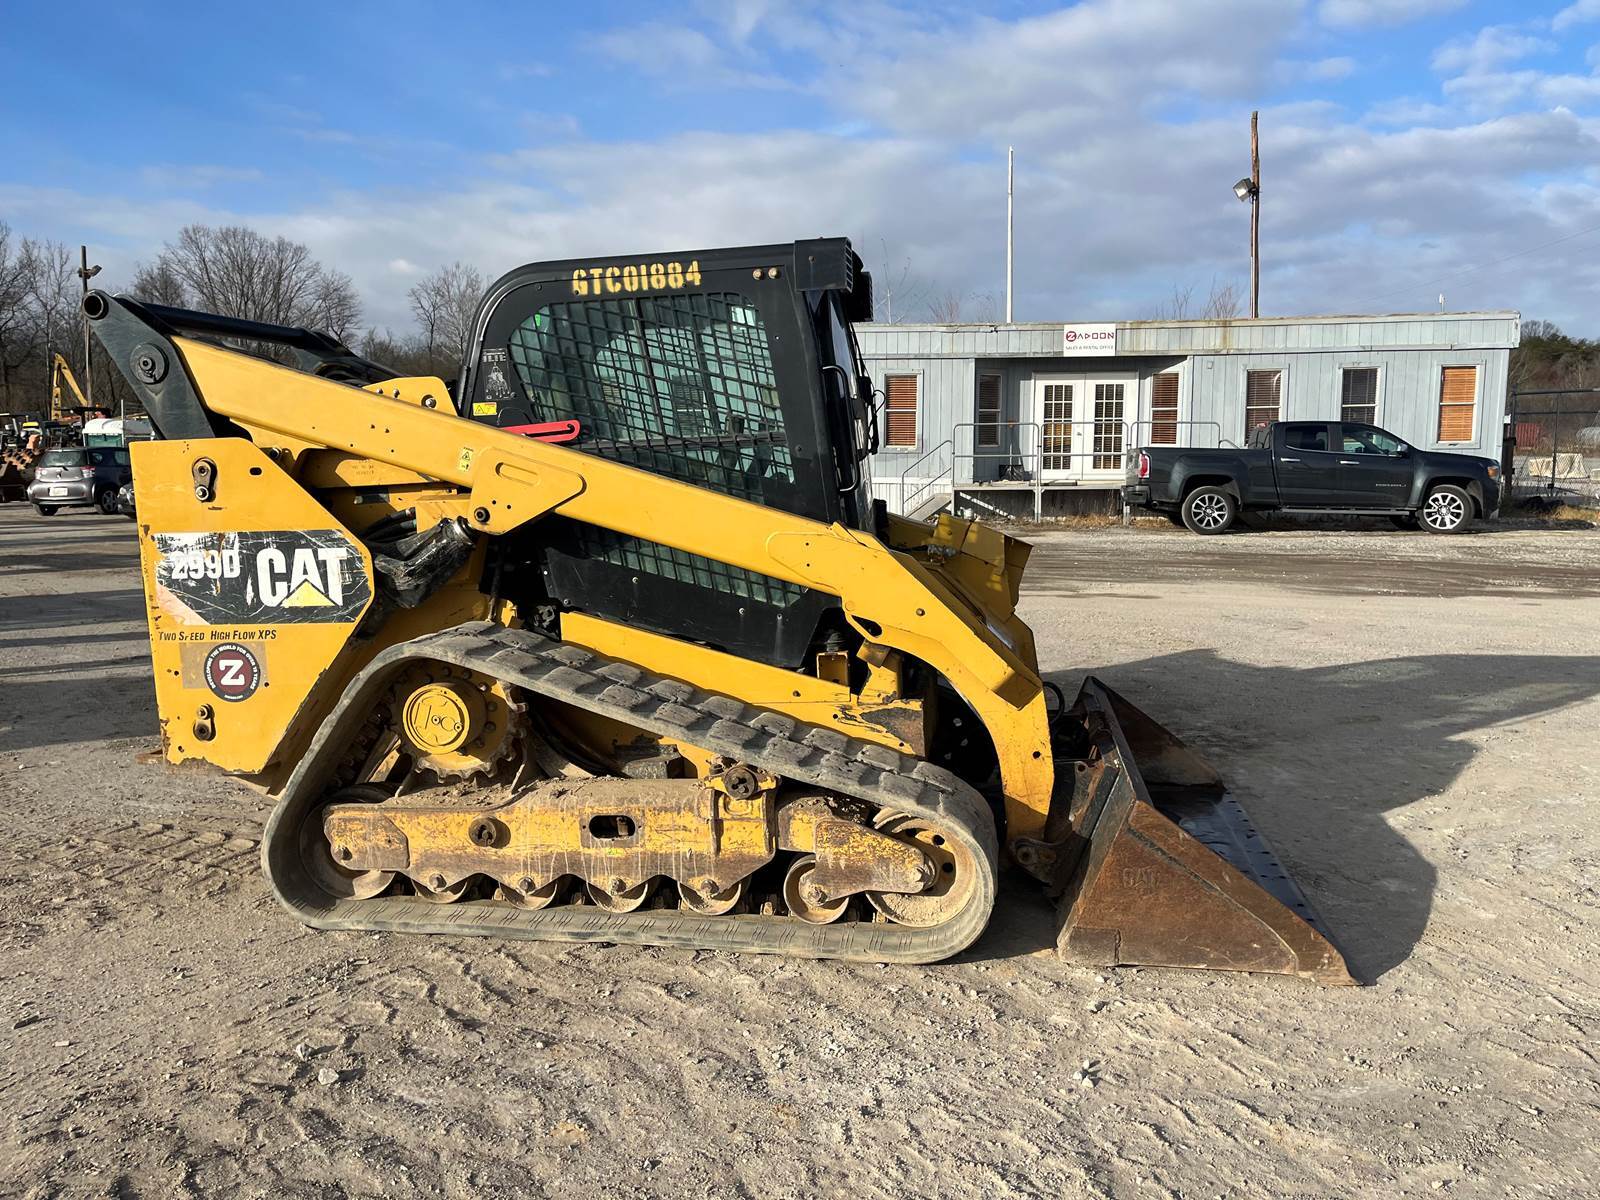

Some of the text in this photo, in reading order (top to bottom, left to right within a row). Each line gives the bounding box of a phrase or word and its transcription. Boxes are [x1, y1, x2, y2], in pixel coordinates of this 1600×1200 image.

[171, 549, 241, 580] 299D
[256, 548, 348, 607] CAT
[257, 629, 277, 640] XPS
[236, 646, 247, 655] FOR
[245, 653, 256, 666] OVER
[219, 659, 245, 686] Z
